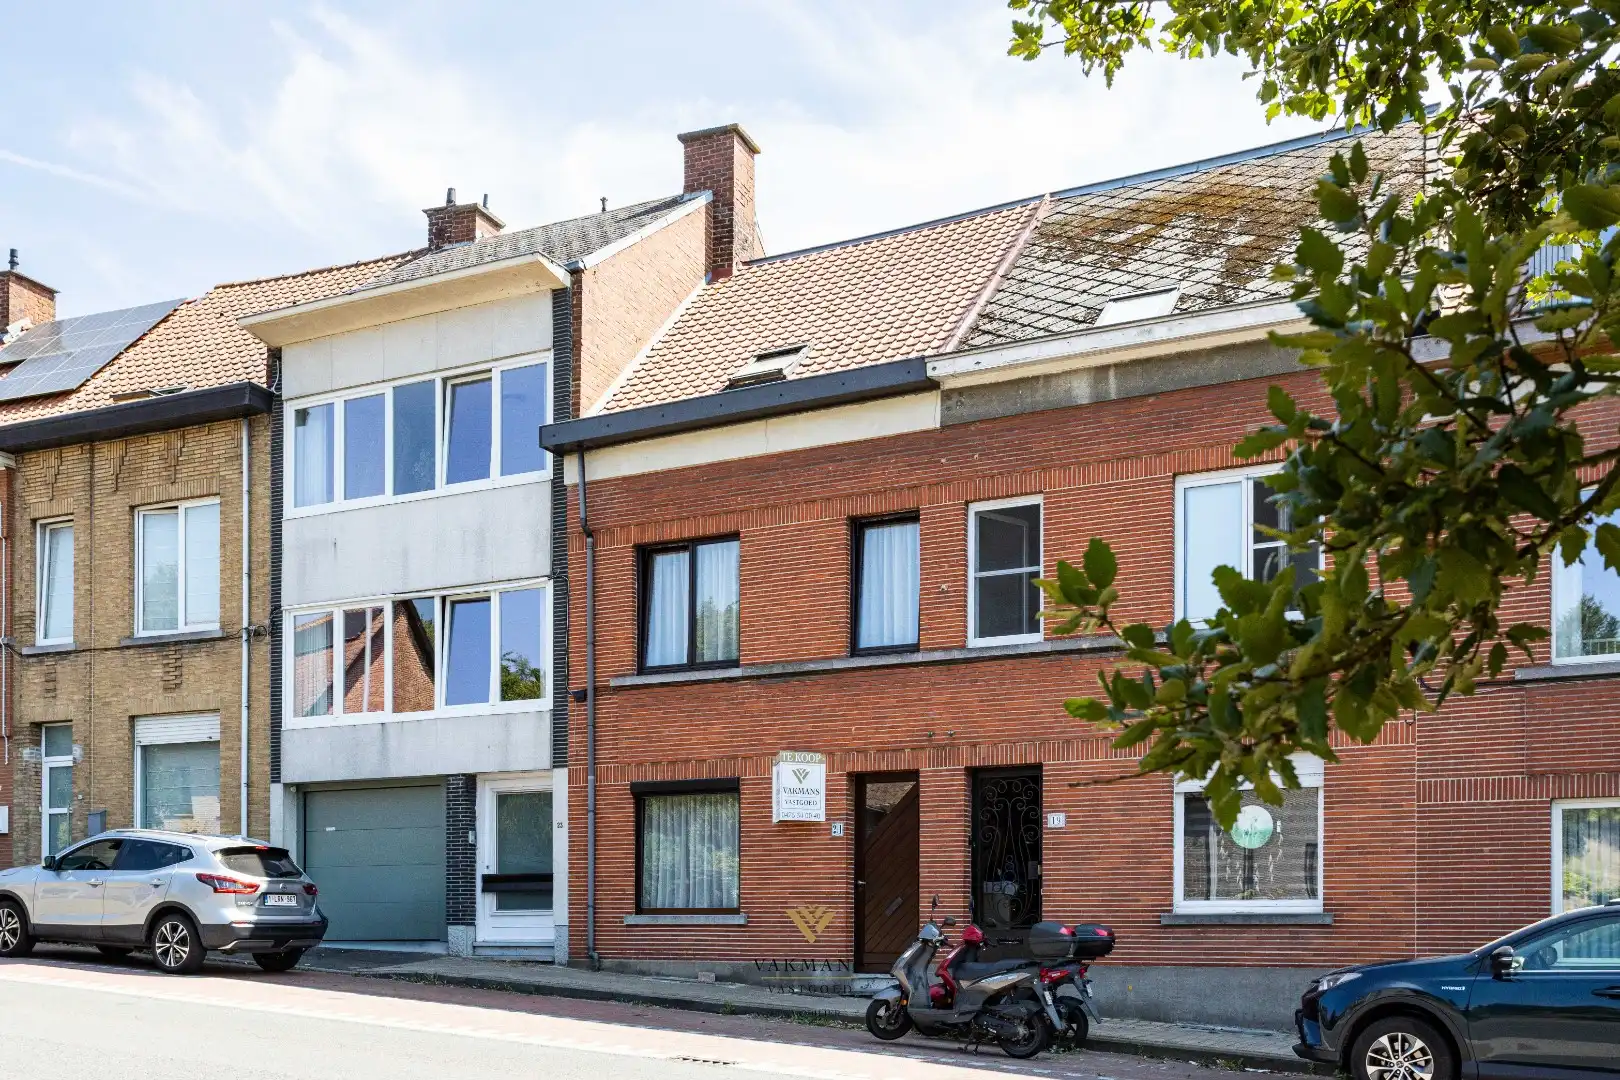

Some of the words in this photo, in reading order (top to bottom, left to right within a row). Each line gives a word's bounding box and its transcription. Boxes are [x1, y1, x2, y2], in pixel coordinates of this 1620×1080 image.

[782, 752, 793, 762] TE
[795, 752, 821, 763] KOOP
[782, 786, 820, 796] VAKMANS
